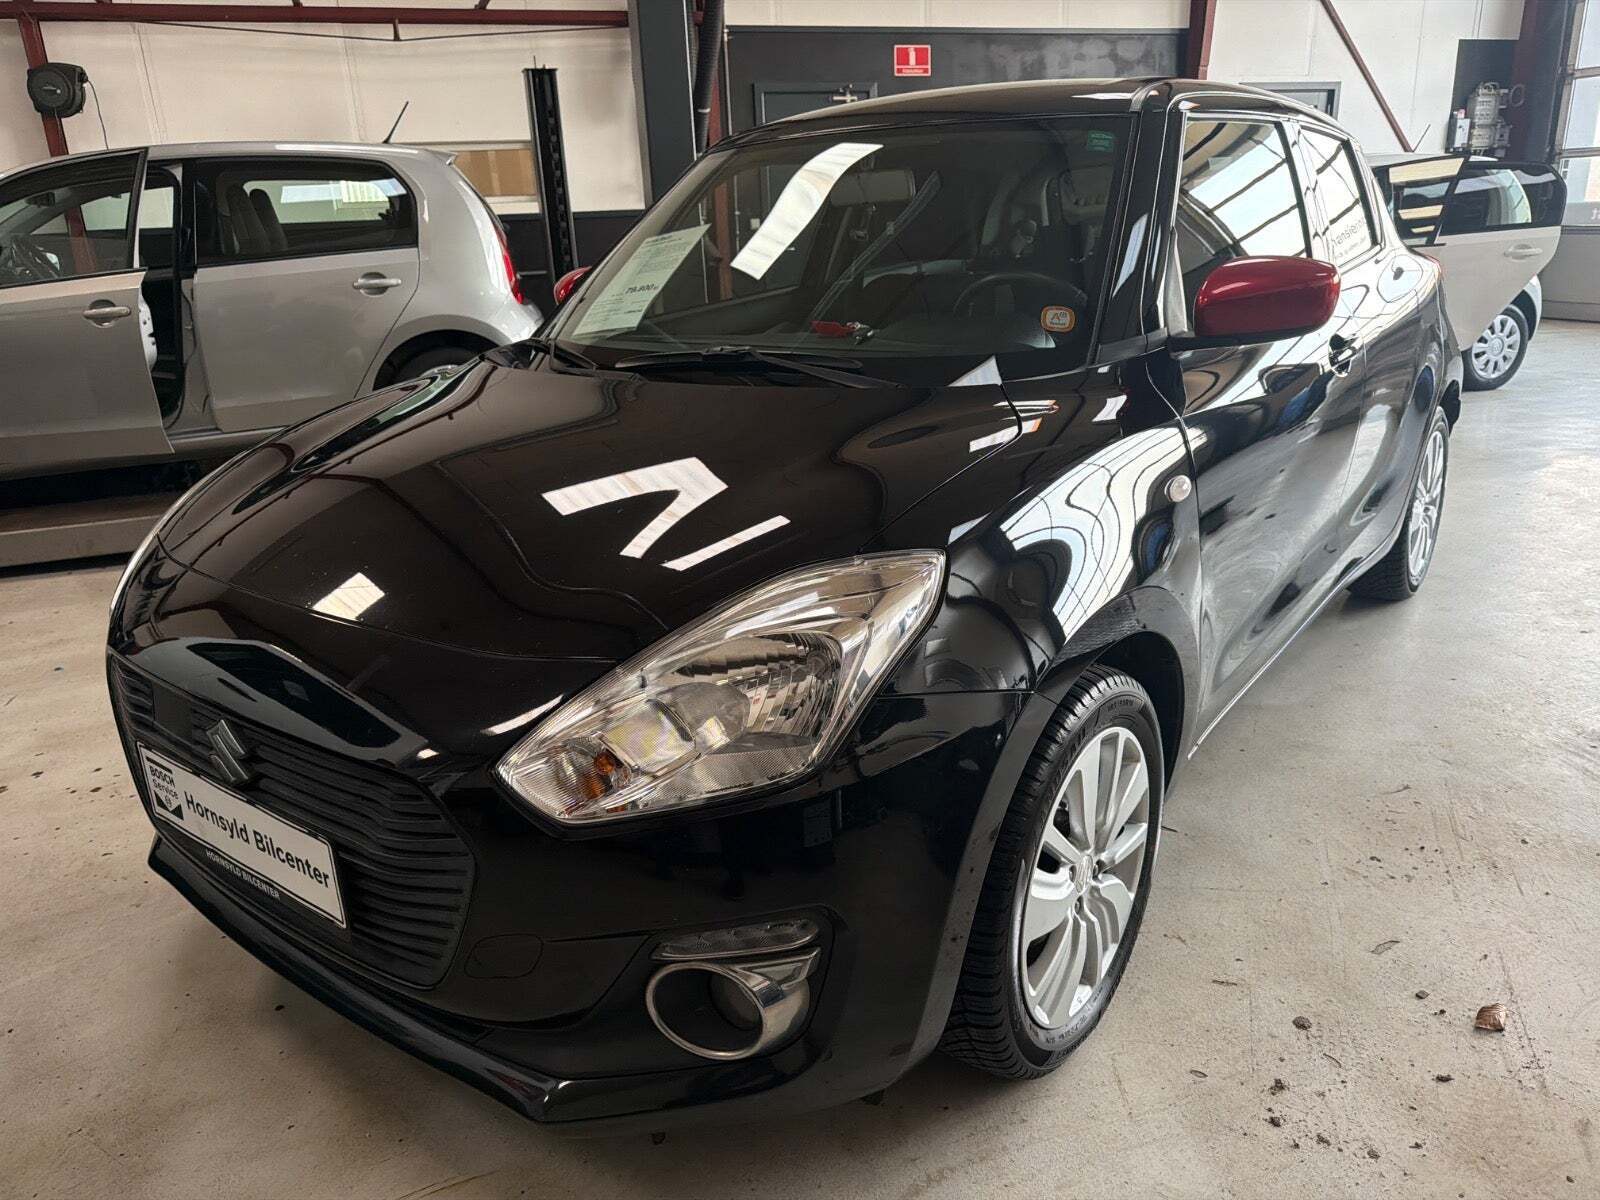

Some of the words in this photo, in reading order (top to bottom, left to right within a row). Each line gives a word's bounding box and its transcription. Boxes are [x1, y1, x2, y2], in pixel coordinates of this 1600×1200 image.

[149, 765, 176, 788] BOSCH
[152, 778, 179, 800] Service
[183, 790, 251, 845] Hornsyld
[252, 829, 330, 888] Bilcenter
[242, 870, 281, 898] BILCENTER
